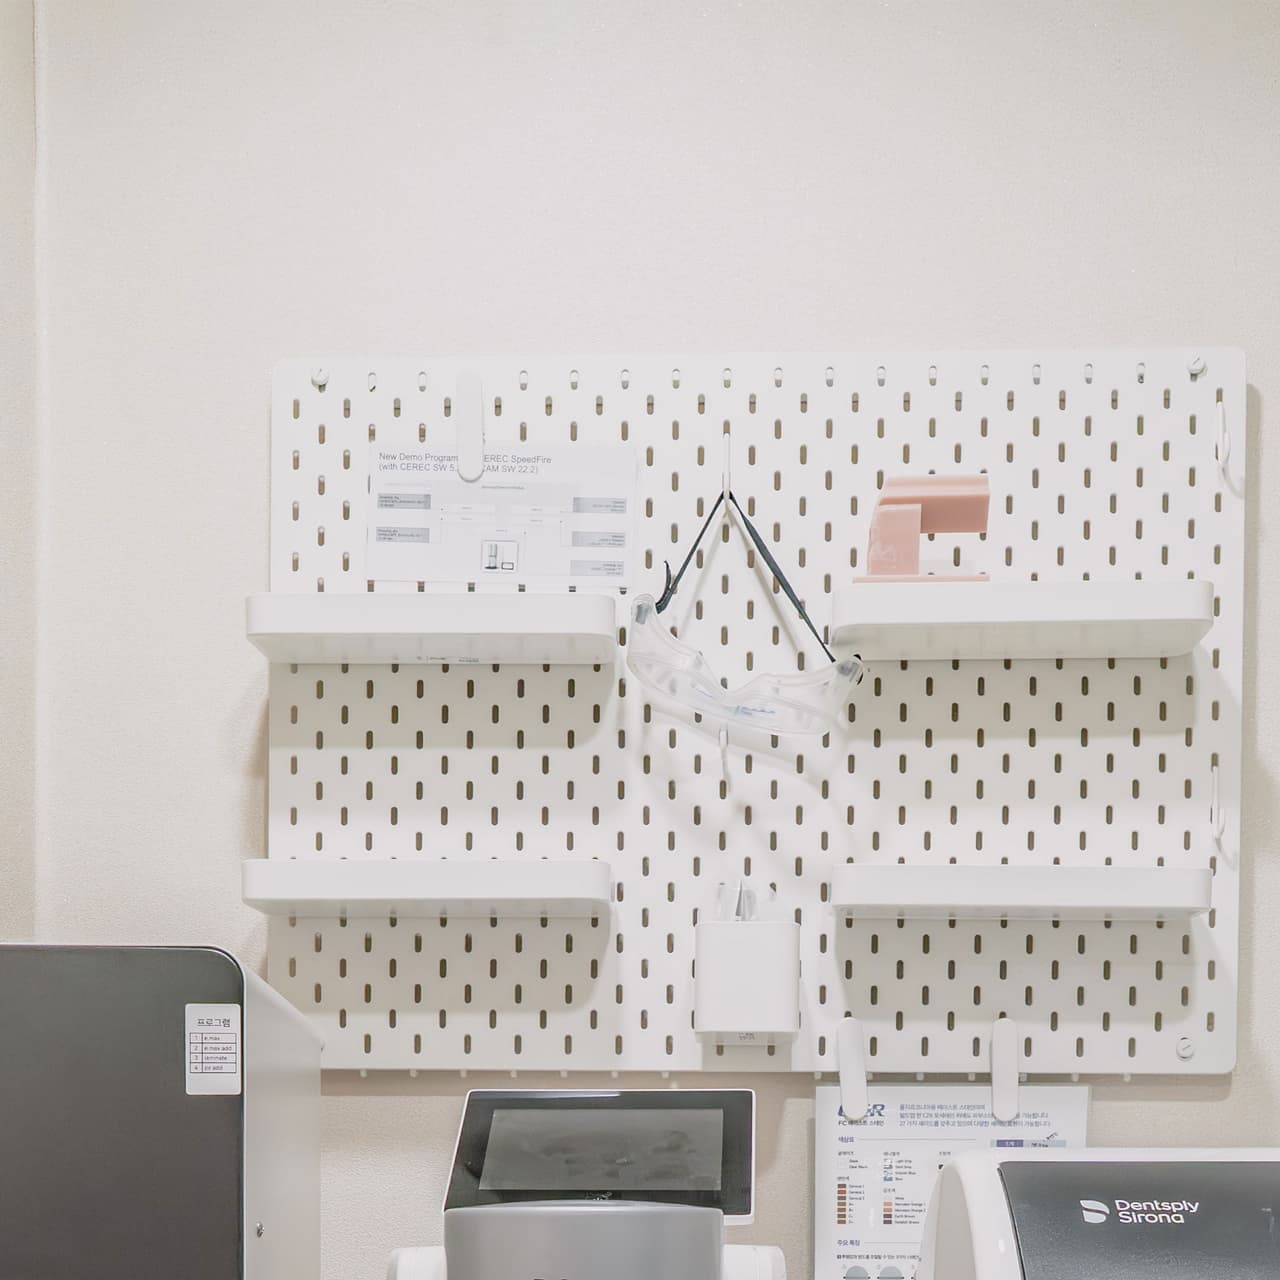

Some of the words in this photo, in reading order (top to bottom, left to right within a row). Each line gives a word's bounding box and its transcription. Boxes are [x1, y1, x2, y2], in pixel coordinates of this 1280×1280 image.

[379, 452, 397, 462] New
[399, 452, 422, 462] Demo
[483, 455, 508, 463] EREC
[511, 455, 551, 465] SpeedFire
[379, 463, 398, 472] (with
[400, 463, 430, 472] CEREC
[432, 464, 447, 472] SW
[501, 465, 516, 473] SW
[518, 466, 539, 474] 22.2)
[197, 1018, 231, 1028] 프로그램
[1114, 1199, 1199, 1213] Dentsply
[1118, 1211, 1185, 1224] Sirona
